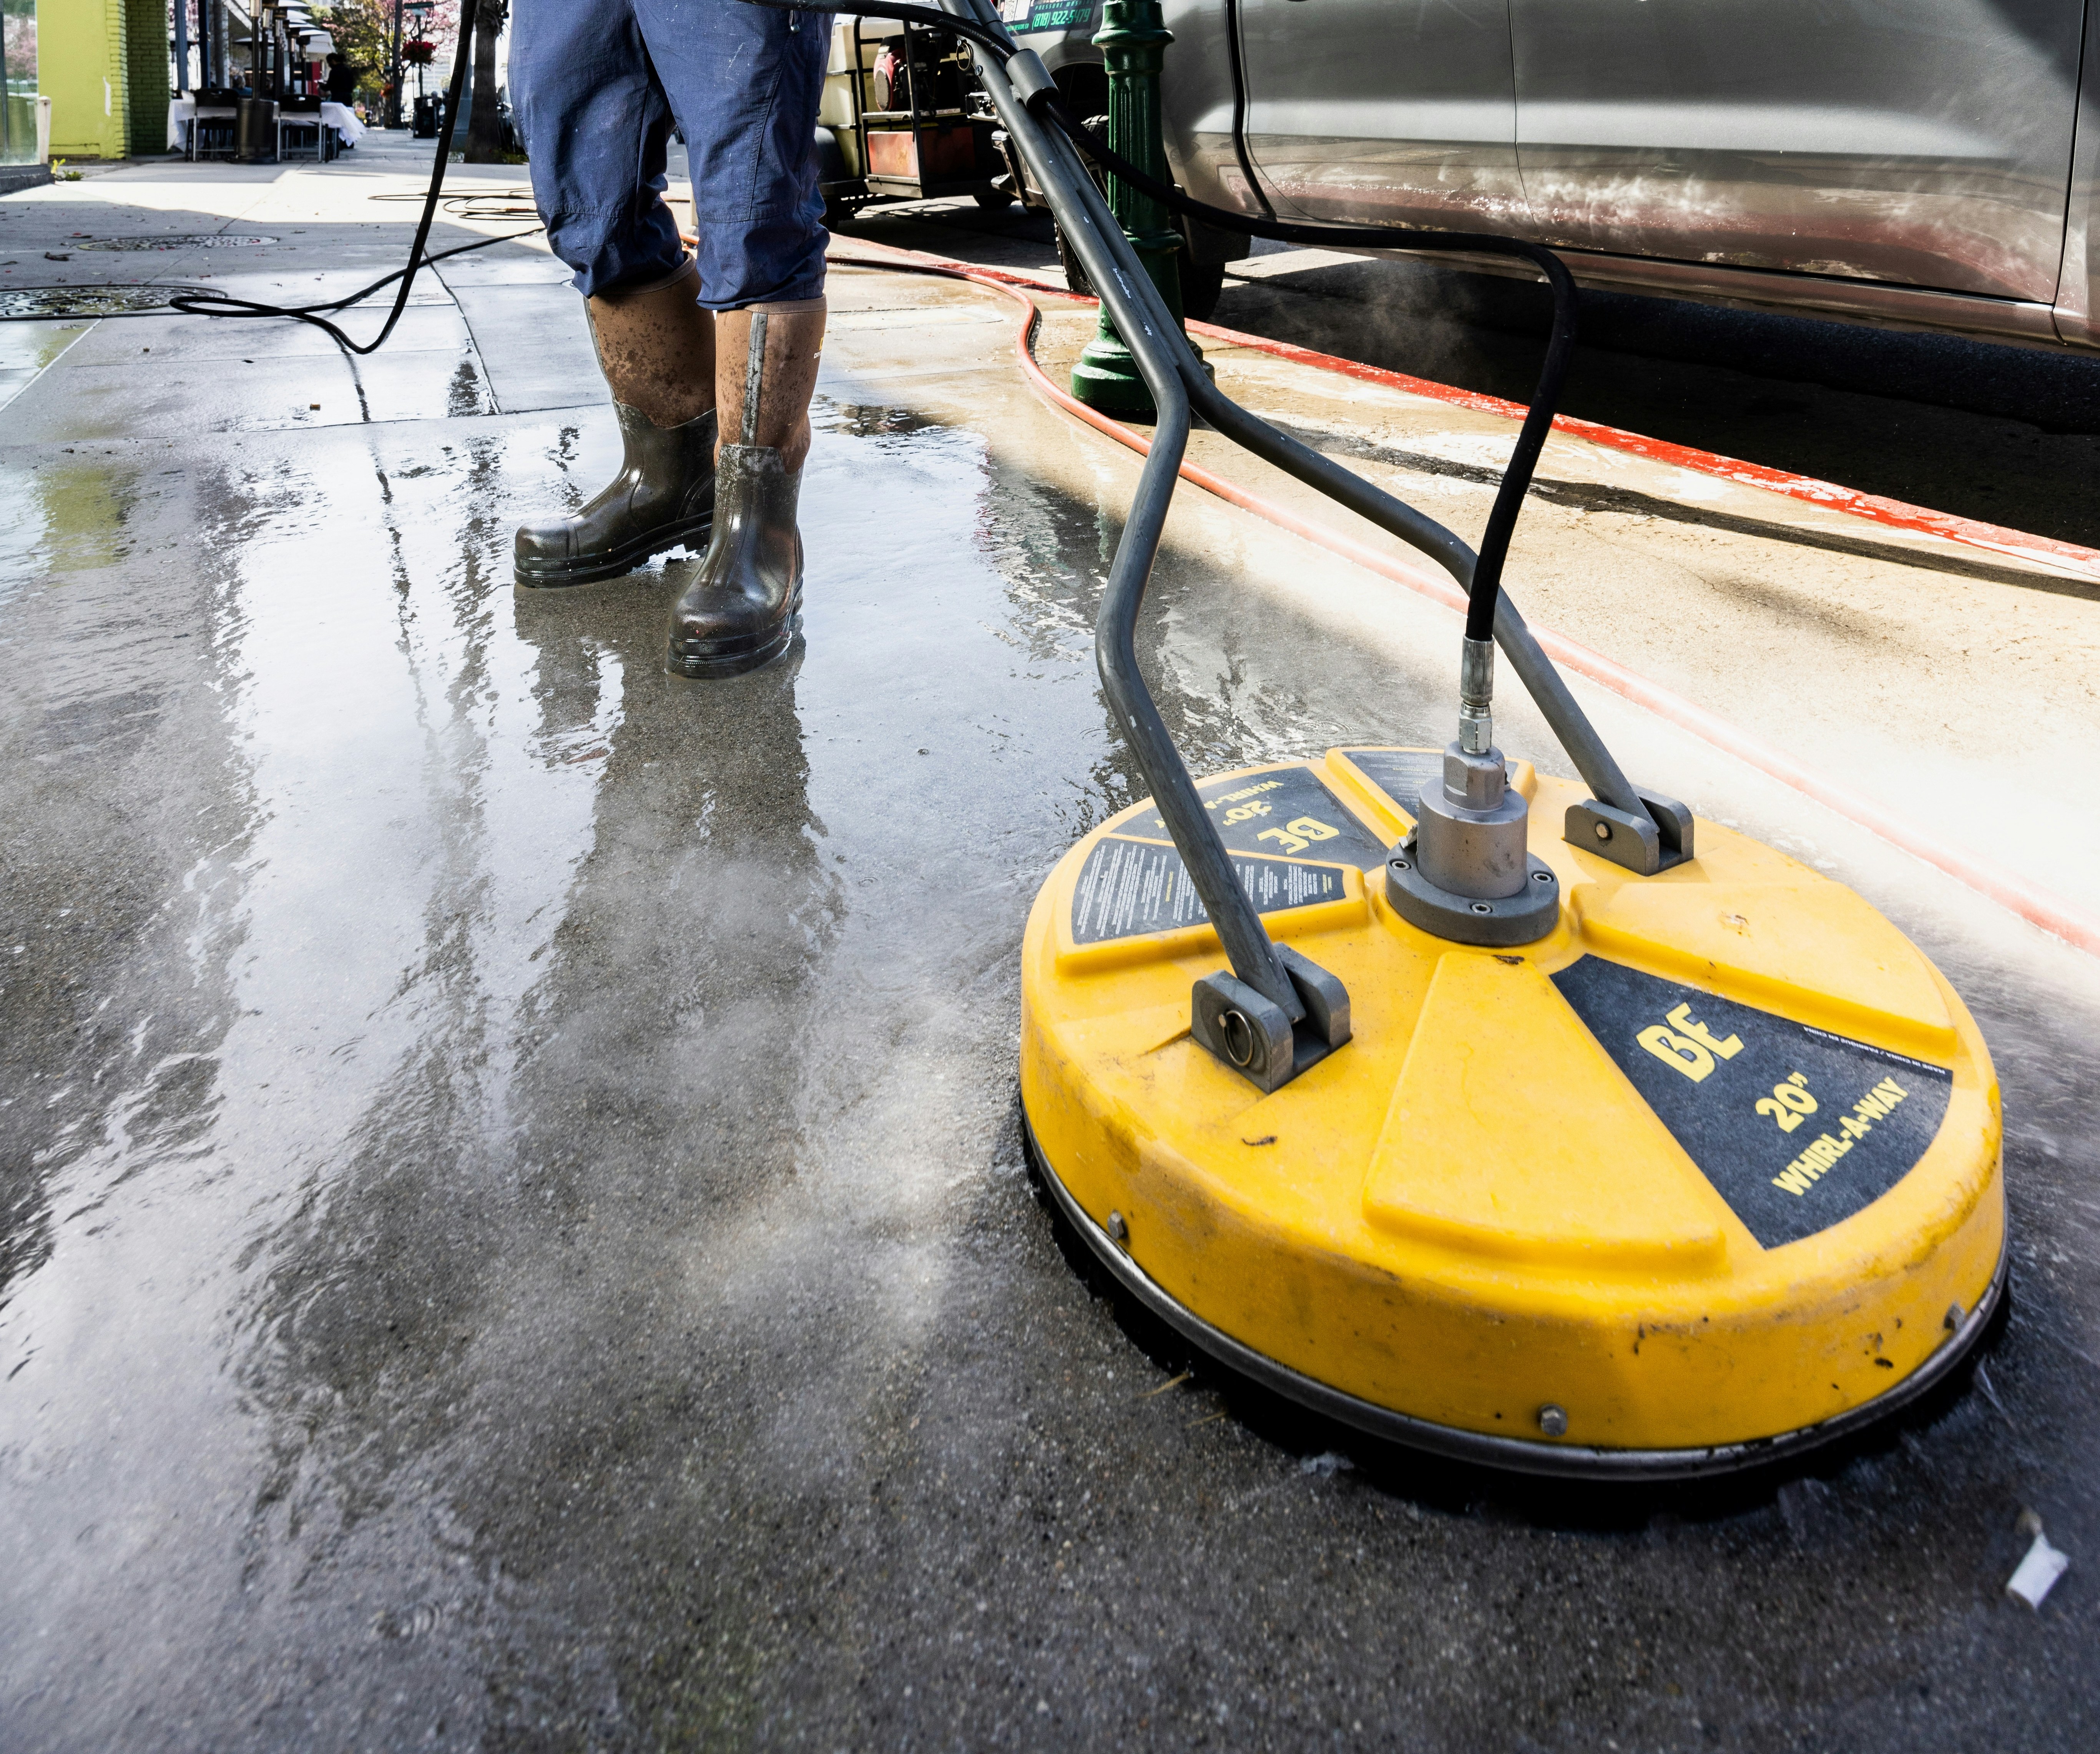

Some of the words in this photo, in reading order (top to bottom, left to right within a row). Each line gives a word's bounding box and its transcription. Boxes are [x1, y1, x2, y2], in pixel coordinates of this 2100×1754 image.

[1035, 2, 1063, 10] PRESSURE
[1032, 12, 1051, 30] (818)
[1050, 8, 1092, 26] 922-5479
[1257, 816, 1340, 855] BE
[1636, 1002, 1744, 1083] BE
[1886, 1052, 1911, 1064] CHINA
[1922, 1063, 1945, 1075] MADE
[1772, 1077, 1908, 1196] WHIRL-A-WAY
